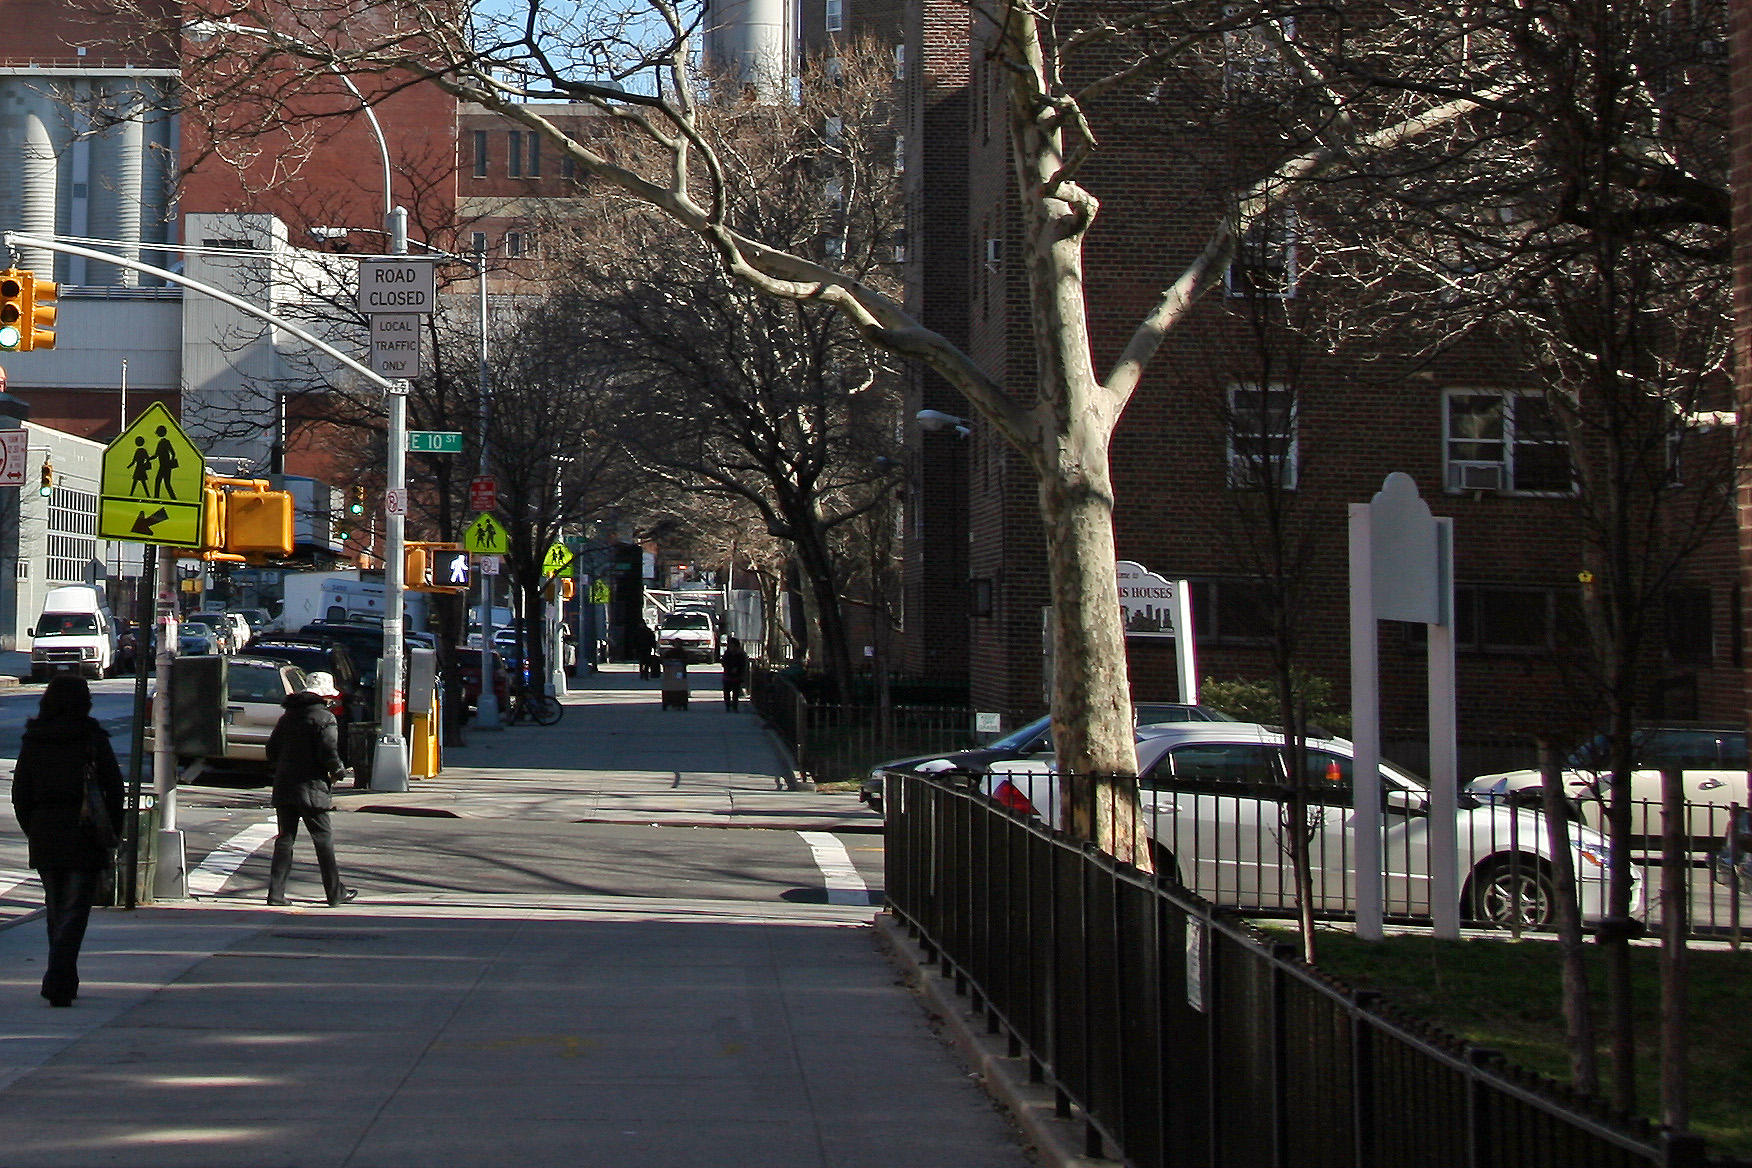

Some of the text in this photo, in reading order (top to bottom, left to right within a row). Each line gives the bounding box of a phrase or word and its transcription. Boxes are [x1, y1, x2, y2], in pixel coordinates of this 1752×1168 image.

[375, 269, 416, 283] ROAD
[369, 291, 425, 306] CLOSED
[379, 321, 412, 332] LOCAL
[375, 340, 416, 351] TRAFFIC
[382, 360, 407, 371] ONLY
[411, 434, 457, 449] E 10 ST
[1118, 586, 1173, 599] IS HOUSES
